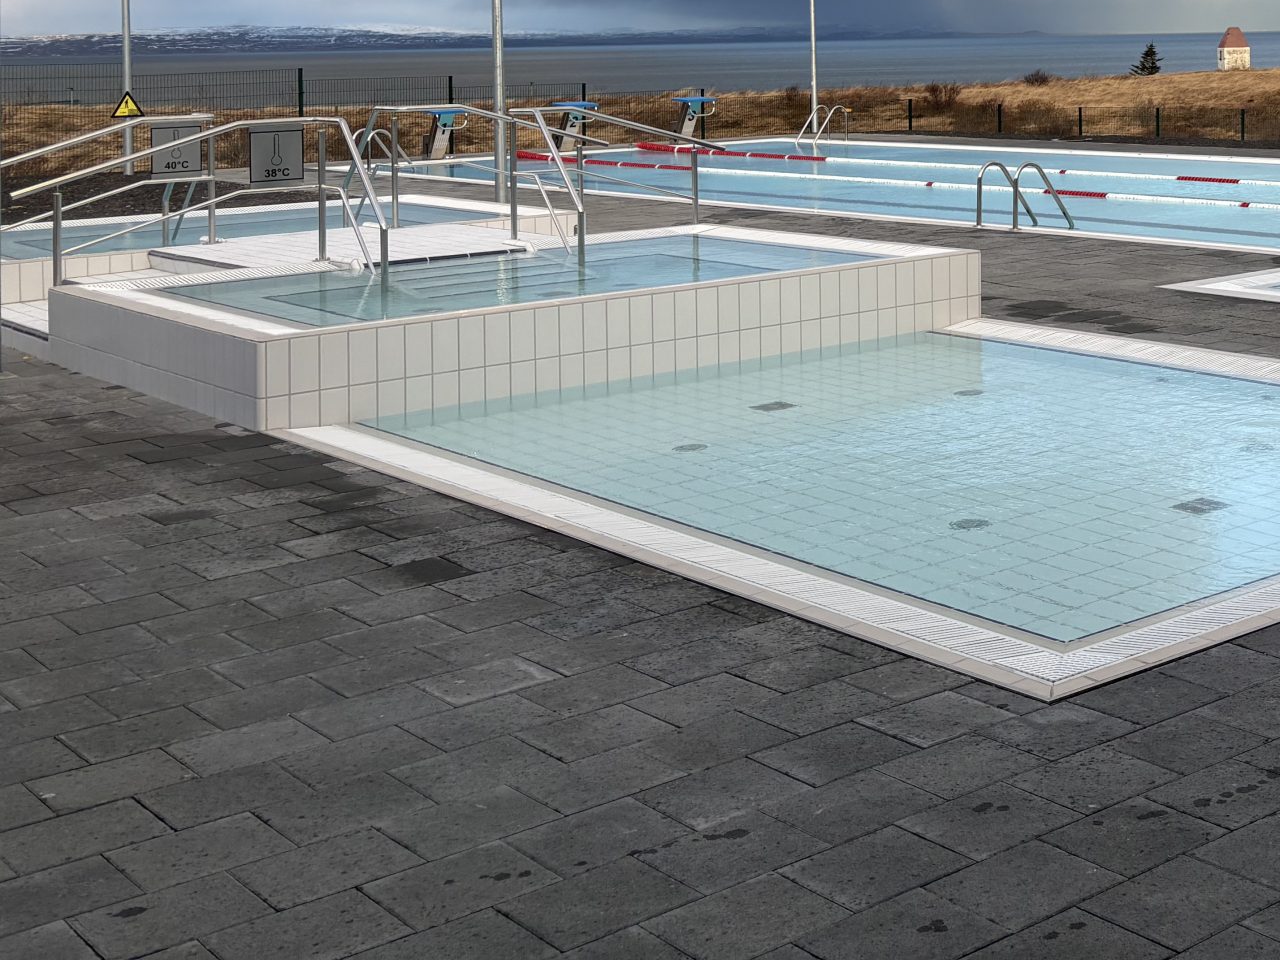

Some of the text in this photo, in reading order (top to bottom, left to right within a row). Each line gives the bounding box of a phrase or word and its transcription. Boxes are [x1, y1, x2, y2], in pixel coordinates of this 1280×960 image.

[570, 116, 579, 127] 2
[164, 160, 189, 170] 40°C
[264, 167, 290, 178] 38°C
